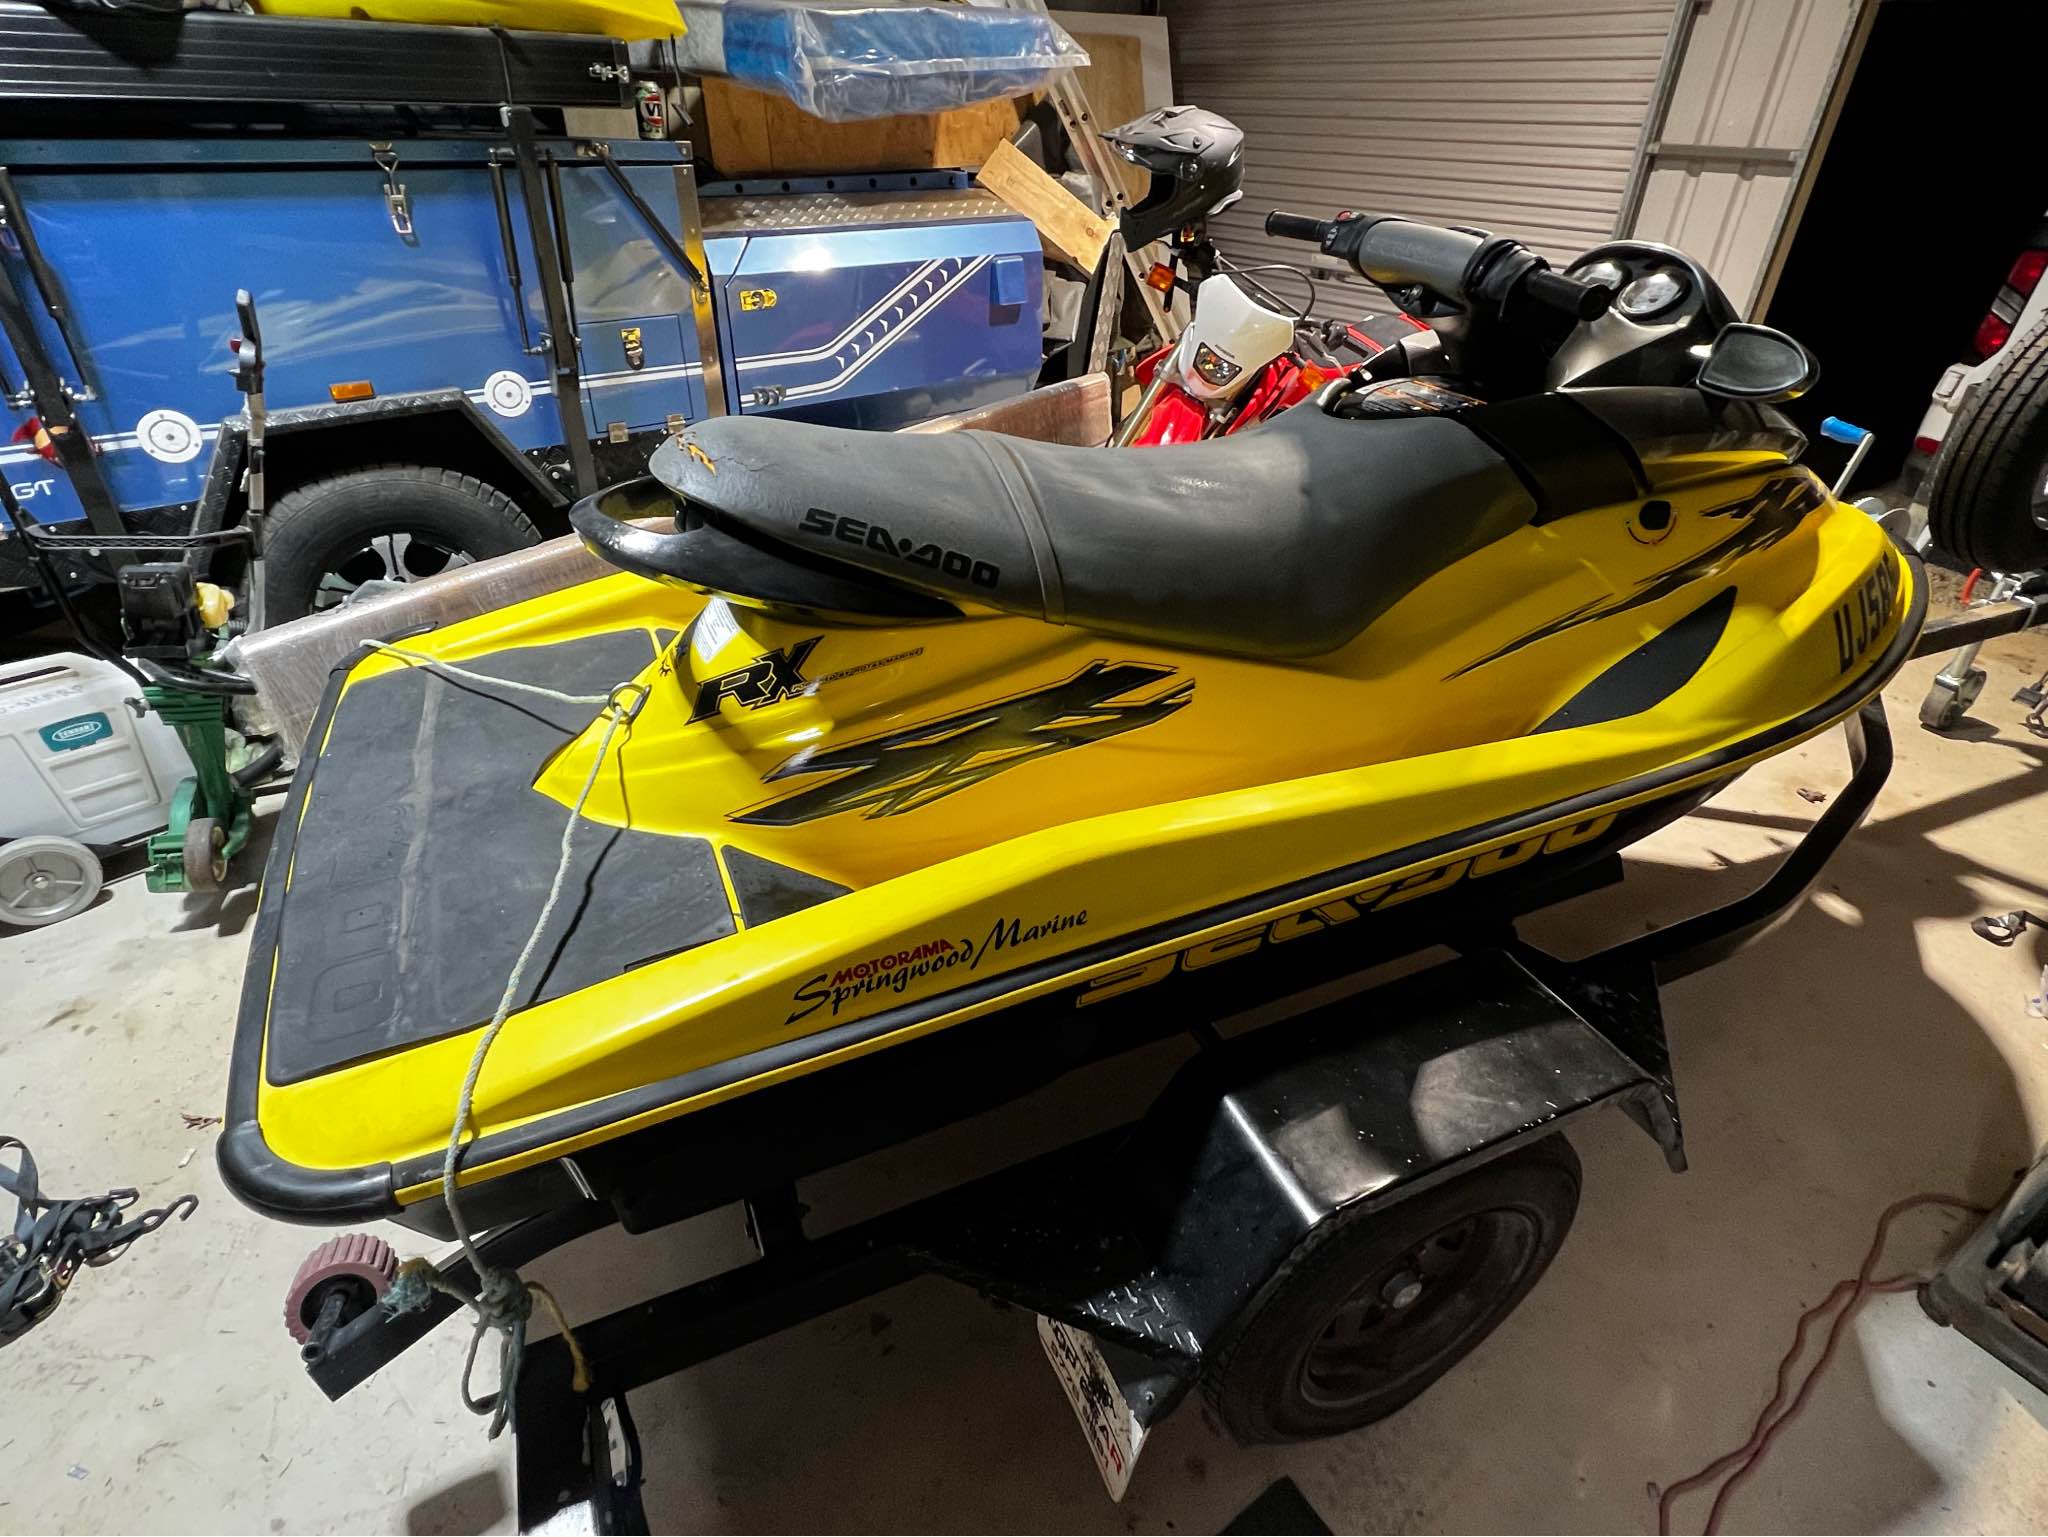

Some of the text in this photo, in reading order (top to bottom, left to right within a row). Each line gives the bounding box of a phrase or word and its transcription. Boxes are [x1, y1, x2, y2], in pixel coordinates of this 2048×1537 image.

[10, 479, 55, 500] GT
[684, 635, 825, 726] RX
[784, 909, 1088, 1026] Springwood Marine
[830, 938, 954, 987] MOTORAMA
